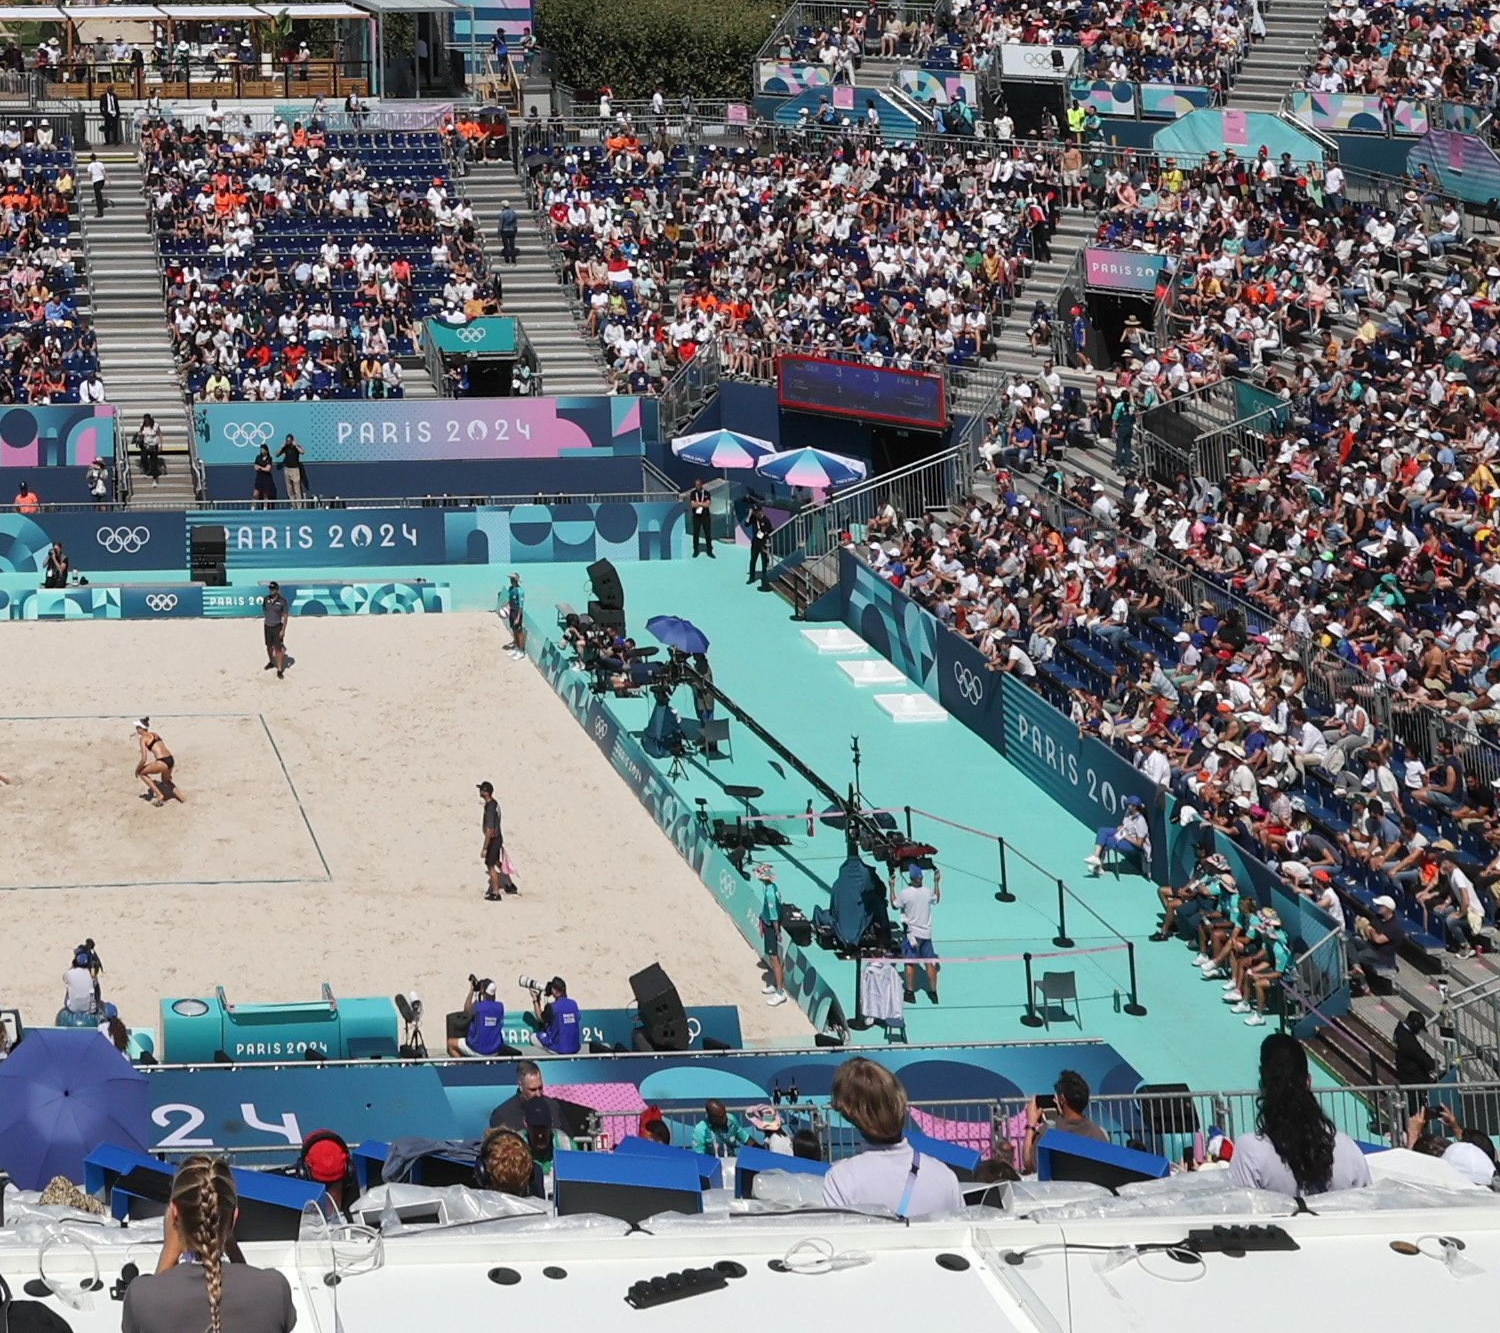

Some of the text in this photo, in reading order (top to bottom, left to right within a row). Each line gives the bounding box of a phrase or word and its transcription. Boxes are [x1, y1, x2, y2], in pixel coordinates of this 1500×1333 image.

[1136, 266, 1155, 277] 20
[446, 419, 531, 443] 2024
[328, 523, 417, 549] 2024
